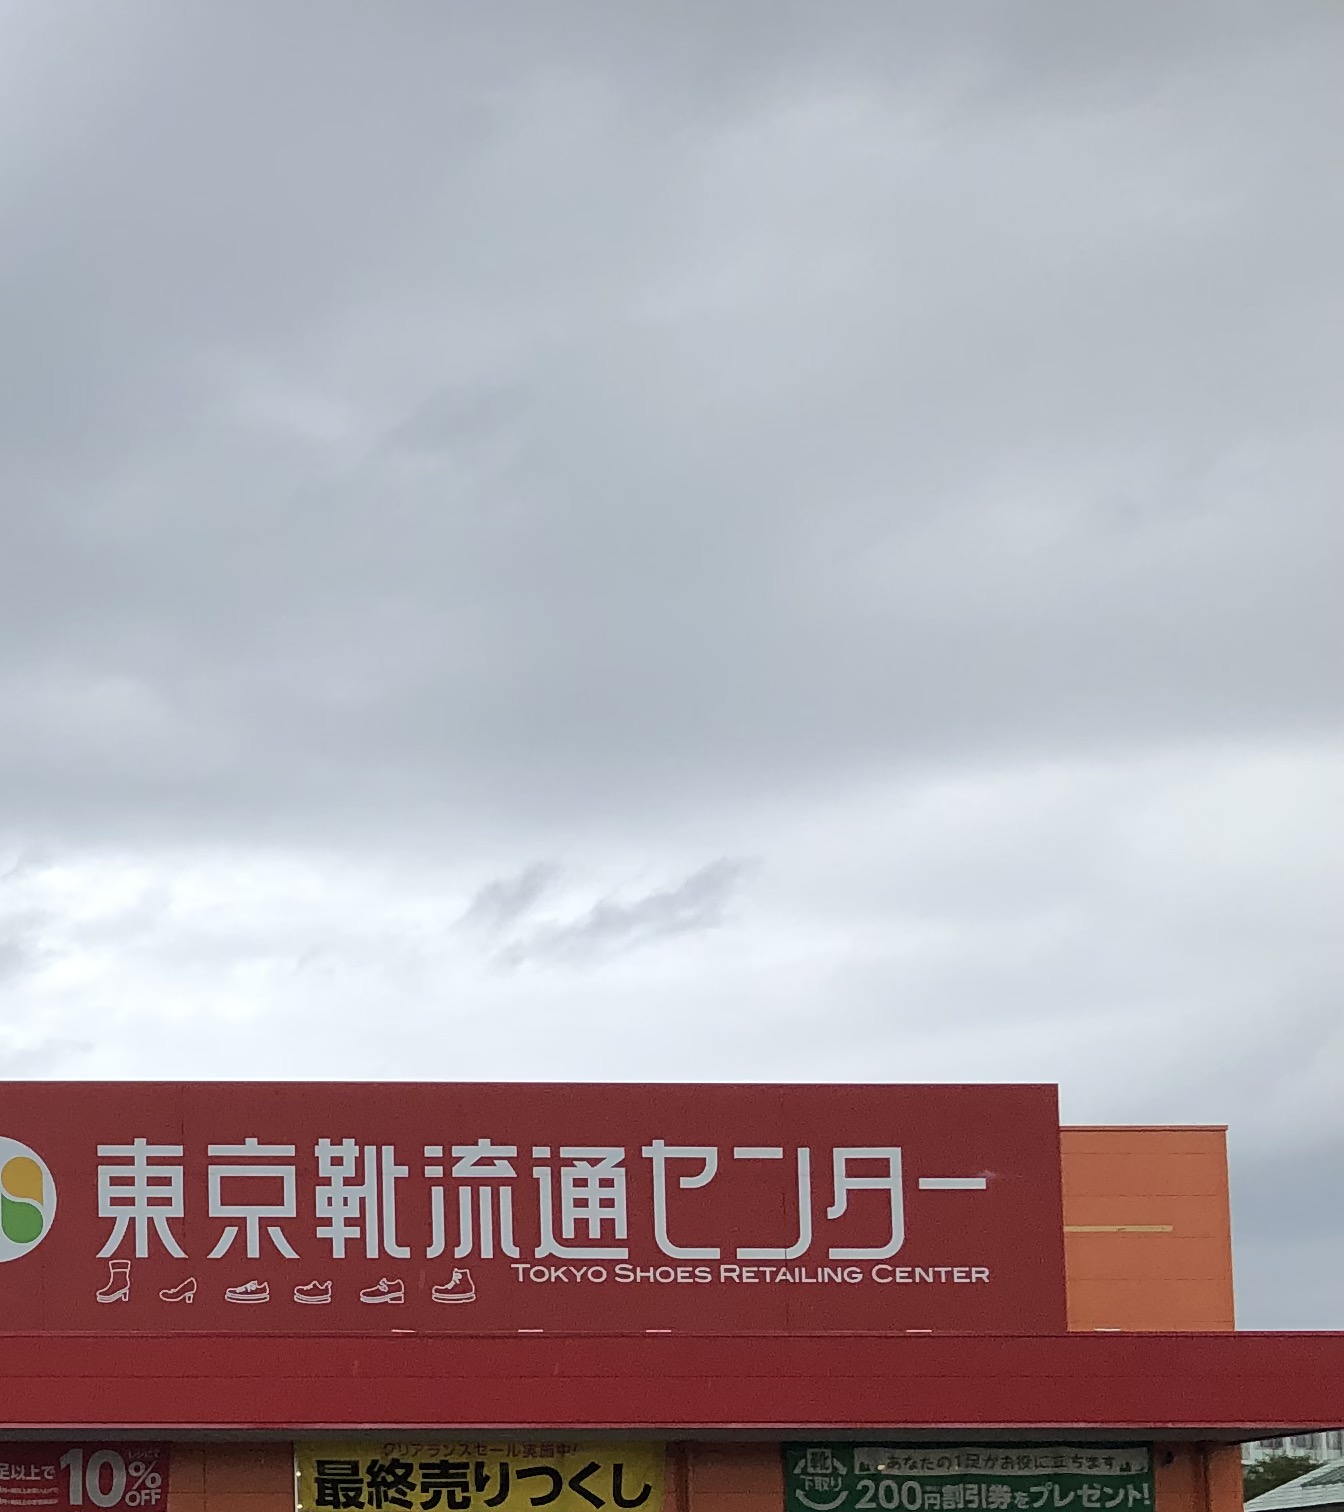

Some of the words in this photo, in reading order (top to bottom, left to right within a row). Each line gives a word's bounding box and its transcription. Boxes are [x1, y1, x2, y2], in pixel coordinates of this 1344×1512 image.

[96, 1138, 987, 1259] 東京靴流通センター
[510, 1263, 608, 1284] TOKYO
[614, 1263, 713, 1284] SHOES
[719, 1264, 864, 1284] RETAILING
[871, 1264, 990, 1284] CENTER
[125, 1489, 162, 1507] OFF
[314, 1458, 653, 1511] 最終売りつくし
[854, 1479, 1151, 1511] 200円割引券をプレゼント!
